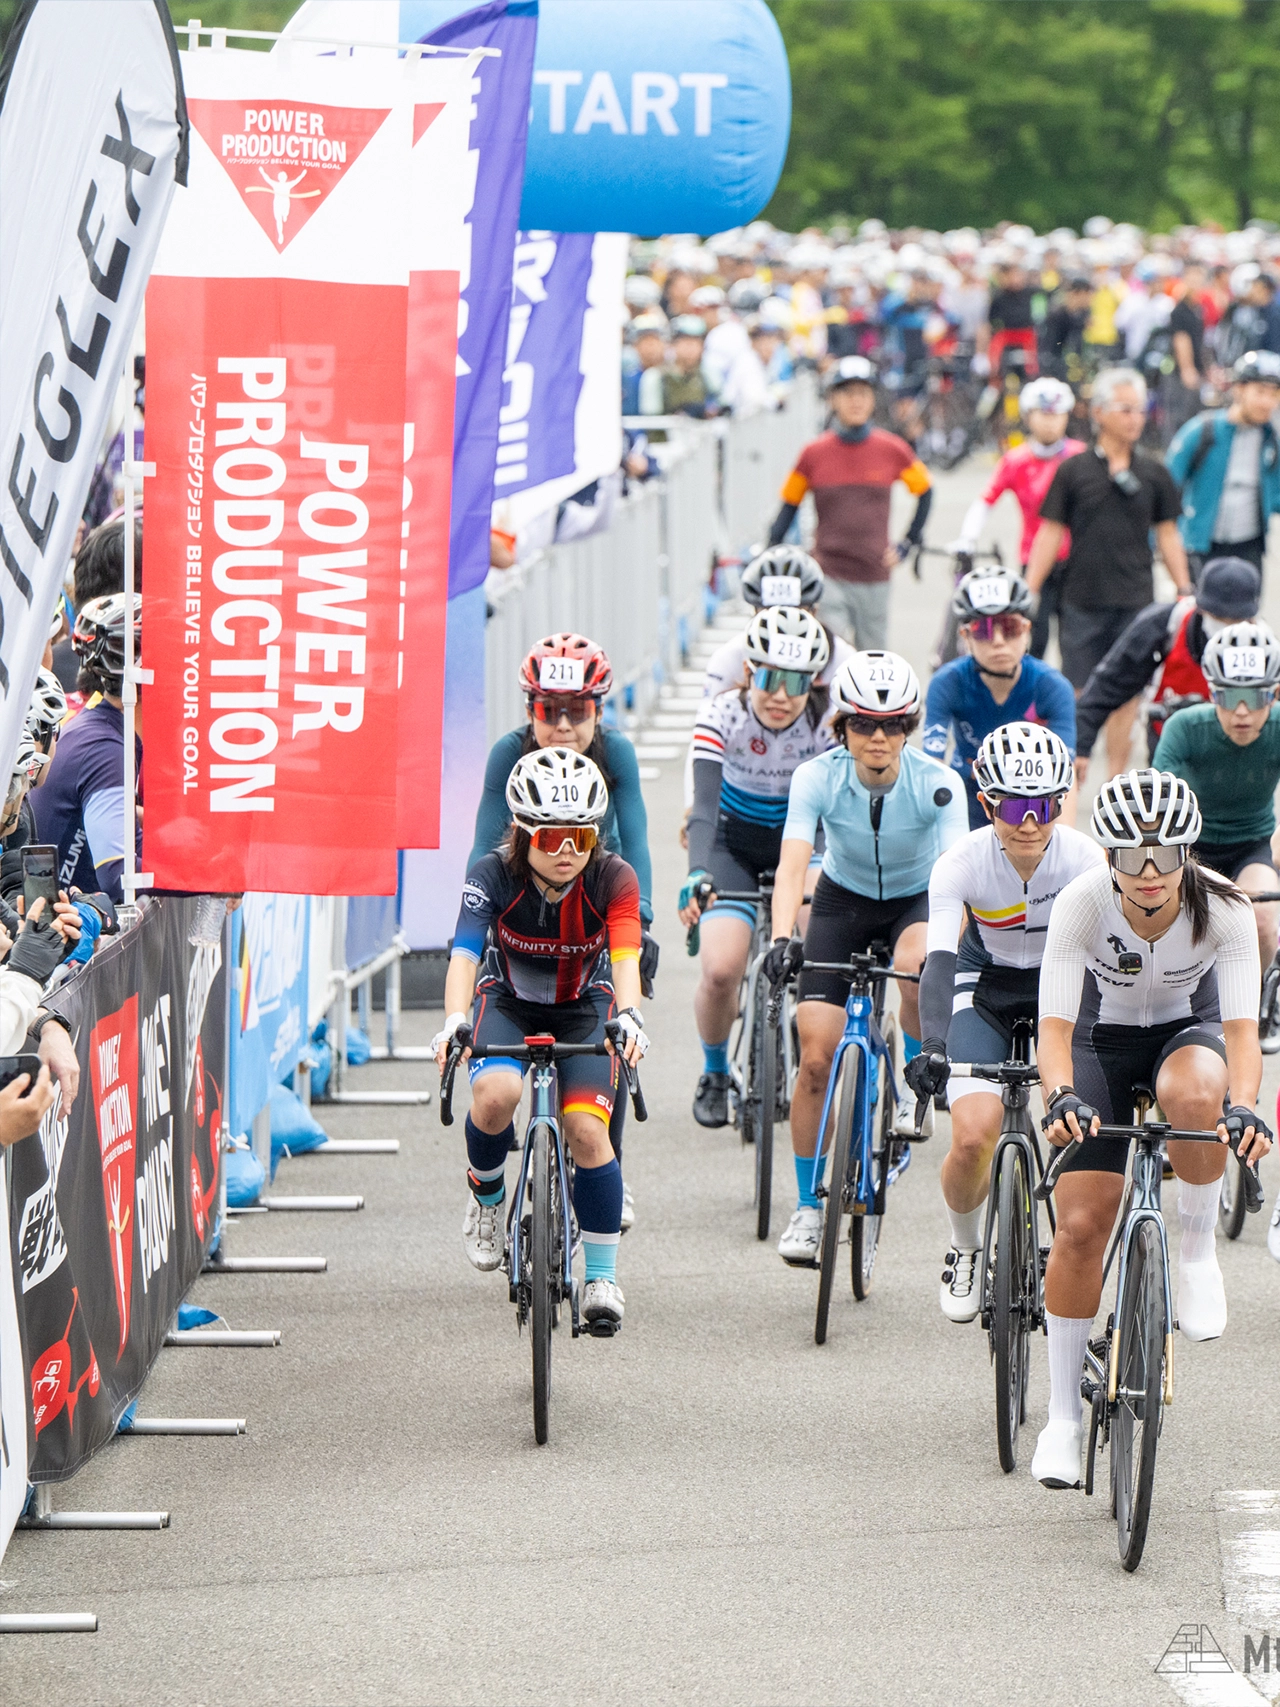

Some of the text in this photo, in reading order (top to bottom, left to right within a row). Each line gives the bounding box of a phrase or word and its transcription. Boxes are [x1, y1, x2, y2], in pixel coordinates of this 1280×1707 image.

[527, 69, 728, 137] TART
[243, 109, 325, 136] POWER
[221, 134, 347, 163] PRODUCTION
[270, 158, 299, 166] BELIEVE
[300, 160, 320, 168] YOUR
[321, 162, 341, 170] GOAL
[182, 373, 207, 795] パワープロダクション BELIEVE YOUR GOAL
[208, 357, 287, 812] PRODUCTION
[292, 432, 370, 741] POWER
[778, 641, 802, 658] 215
[1232, 653, 1256, 668] 218
[548, 664, 574, 680] 211
[869, 669, 895, 682] 212
[1015, 759, 1043, 776] 206
[551, 784, 579, 803] 210
[501, 928, 603, 954] INFINITY STYLE
